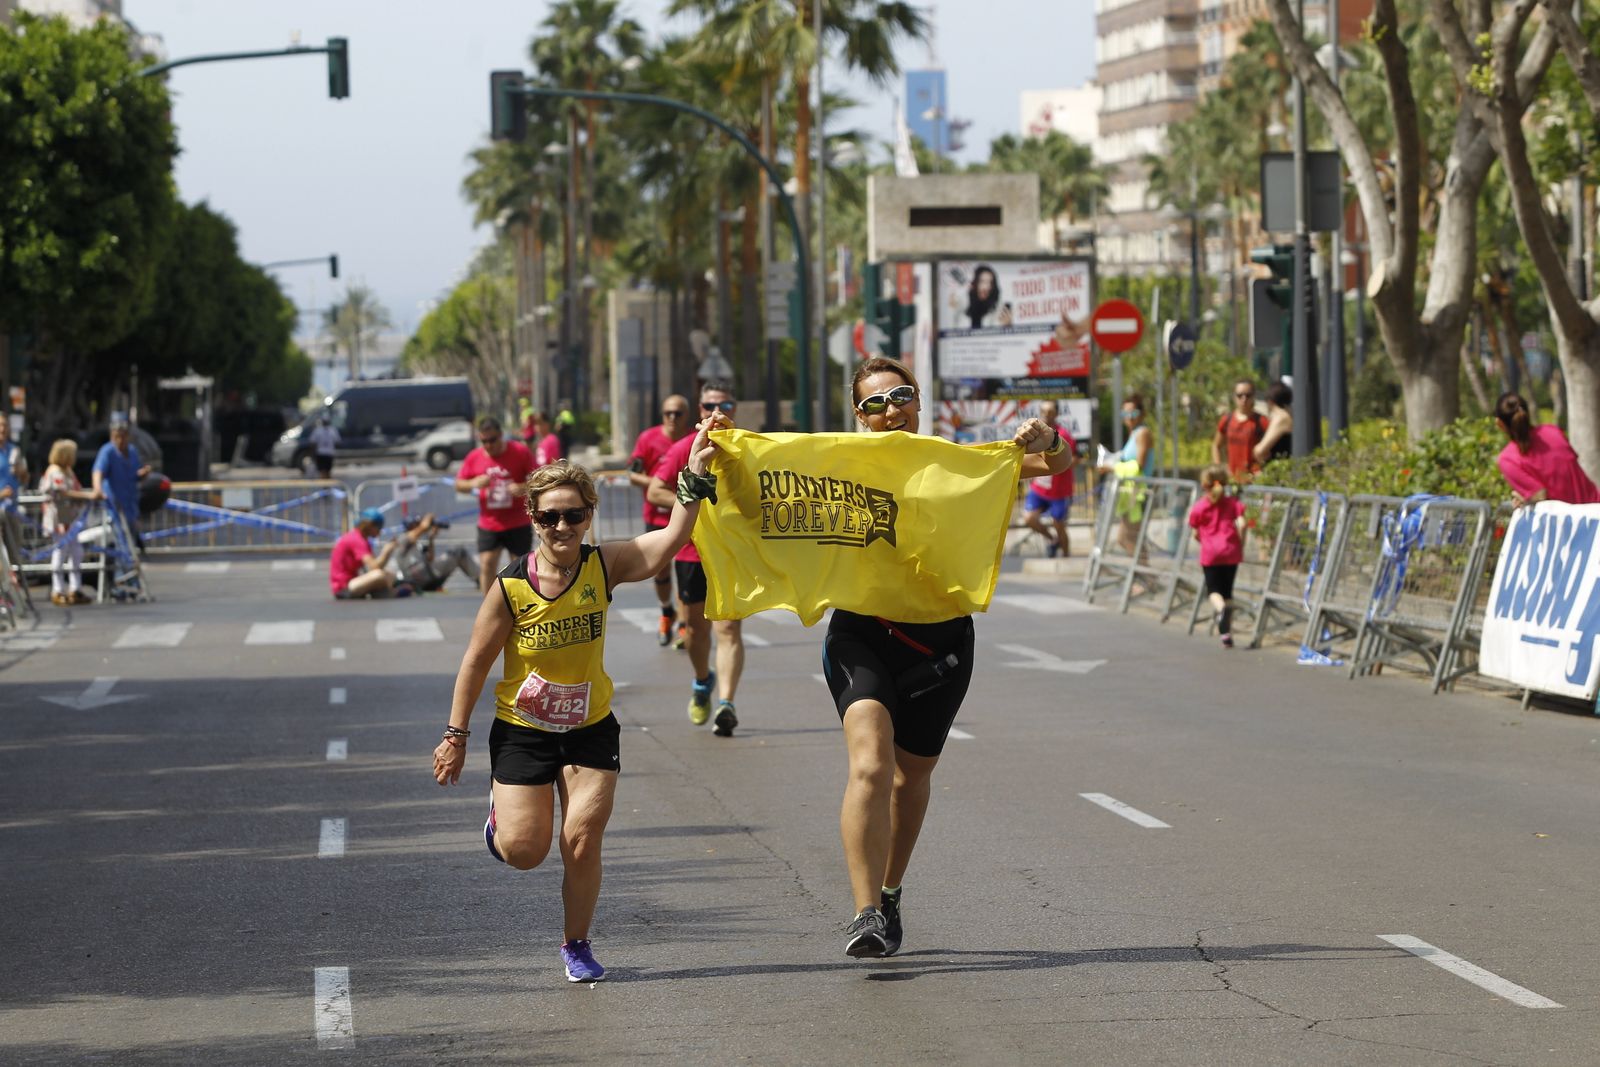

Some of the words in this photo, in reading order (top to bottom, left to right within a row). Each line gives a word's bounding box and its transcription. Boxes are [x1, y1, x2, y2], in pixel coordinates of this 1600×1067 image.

[758, 470, 867, 509] RUNNERS
[761, 499, 872, 535] FOREVER
[872, 494, 891, 534] TEAM
[593, 612, 603, 638] TEAM
[540, 696, 584, 713] 1182
